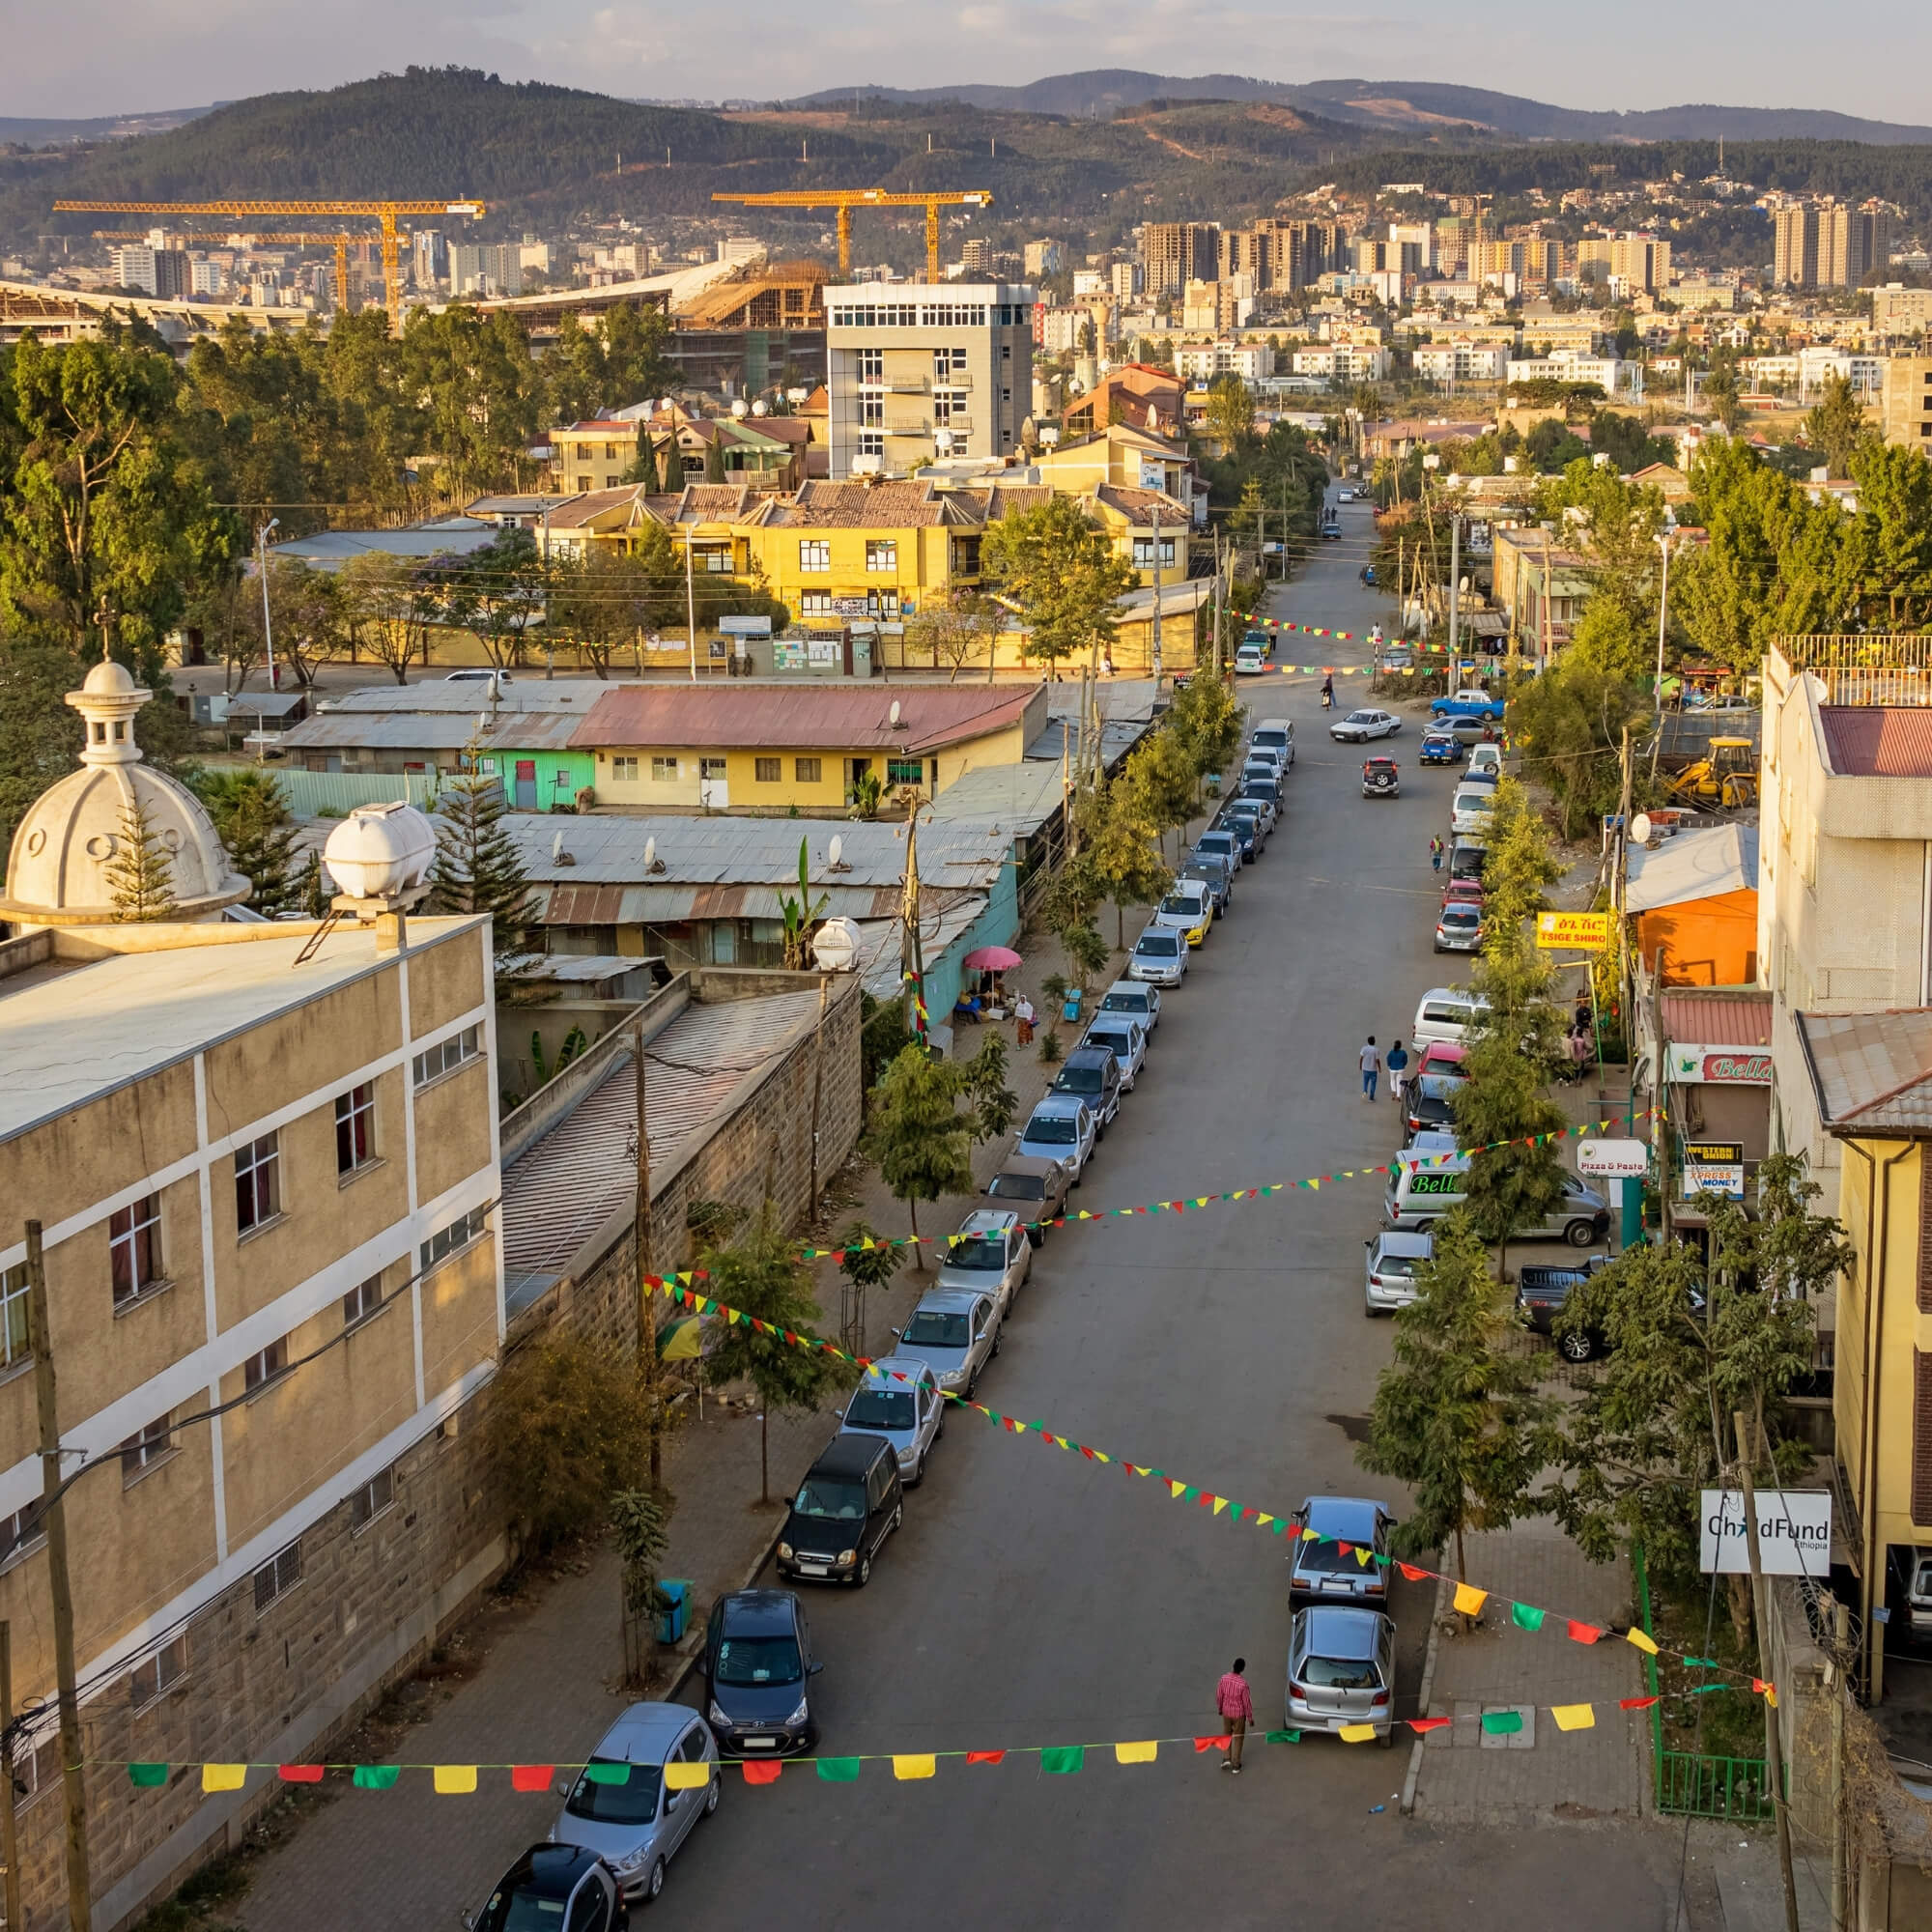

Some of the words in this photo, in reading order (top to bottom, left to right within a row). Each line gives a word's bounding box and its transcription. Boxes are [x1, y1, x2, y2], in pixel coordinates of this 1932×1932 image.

[1541, 933, 1571, 942] TSIGE
[1575, 934, 1605, 943] SHIRO
[1712, 1057, 1772, 1078] Bella
[1708, 1516, 1828, 1540] ChdFund
